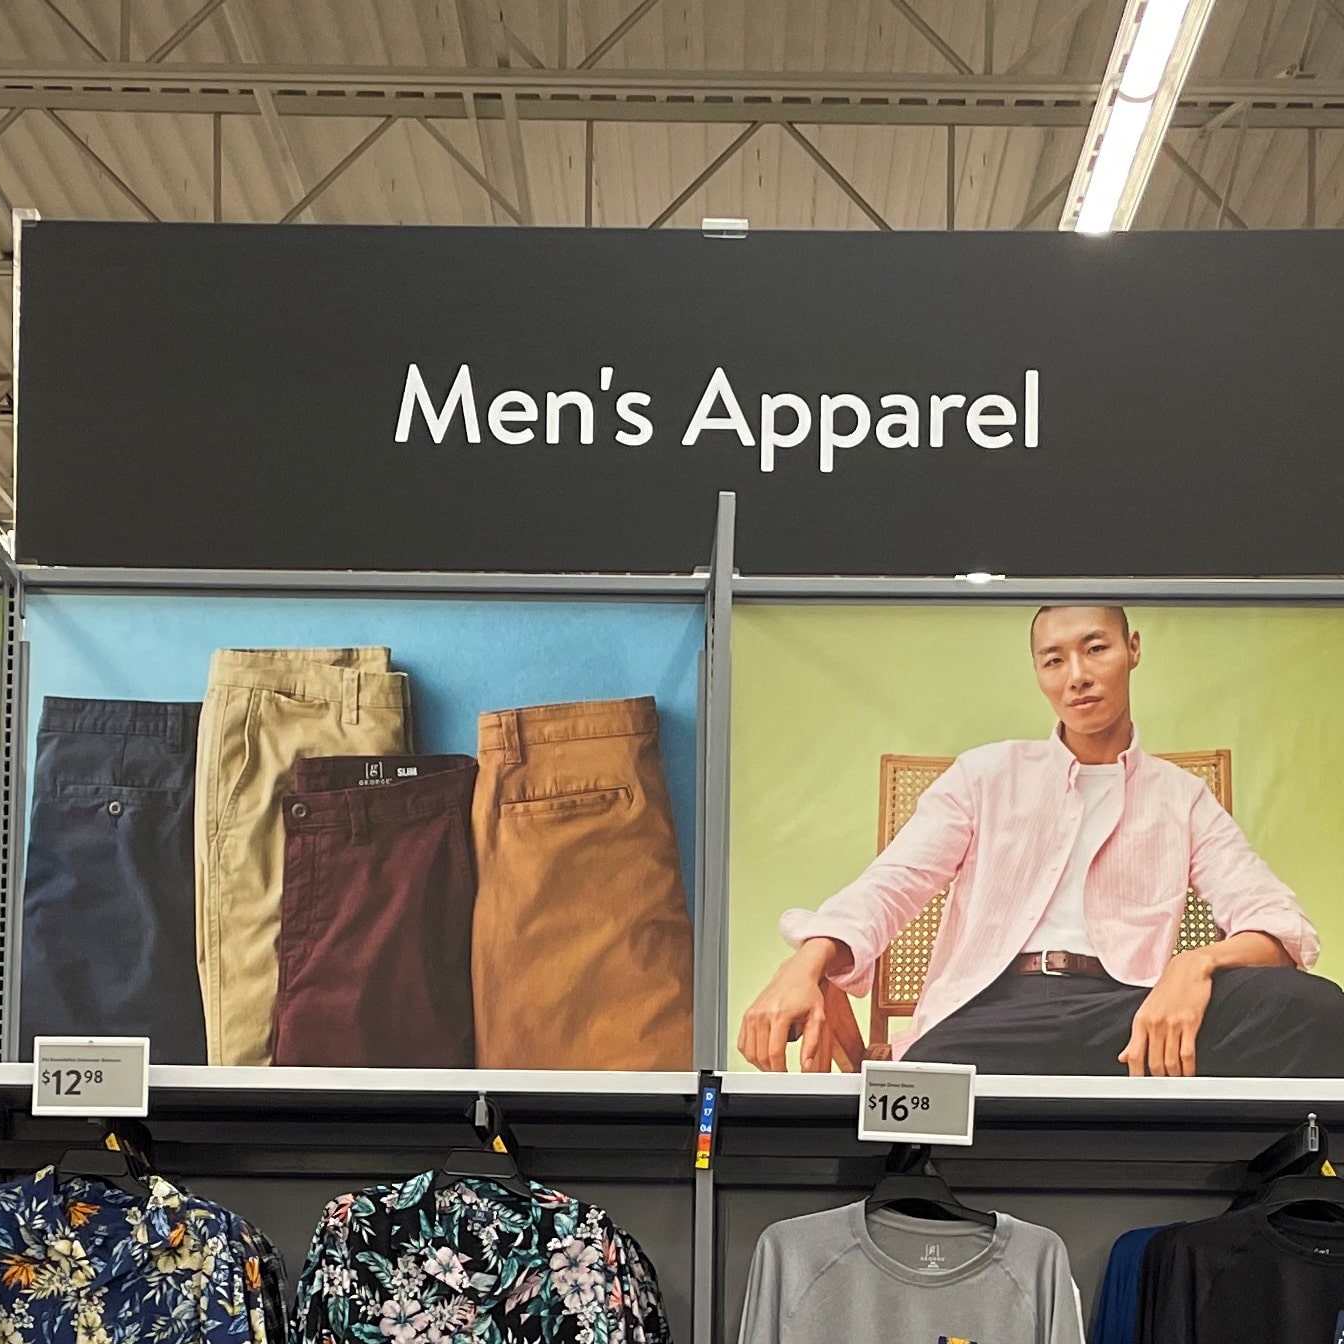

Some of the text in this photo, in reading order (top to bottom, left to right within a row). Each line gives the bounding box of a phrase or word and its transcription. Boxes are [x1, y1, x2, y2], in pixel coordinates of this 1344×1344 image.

[395, 363, 1038, 473] Men's Apparel
[397, 767, 418, 777] SLIM
[705, 1092, 714, 1101] D
[703, 1108, 713, 1116] 17
[699, 1124, 712, 1133] 04
